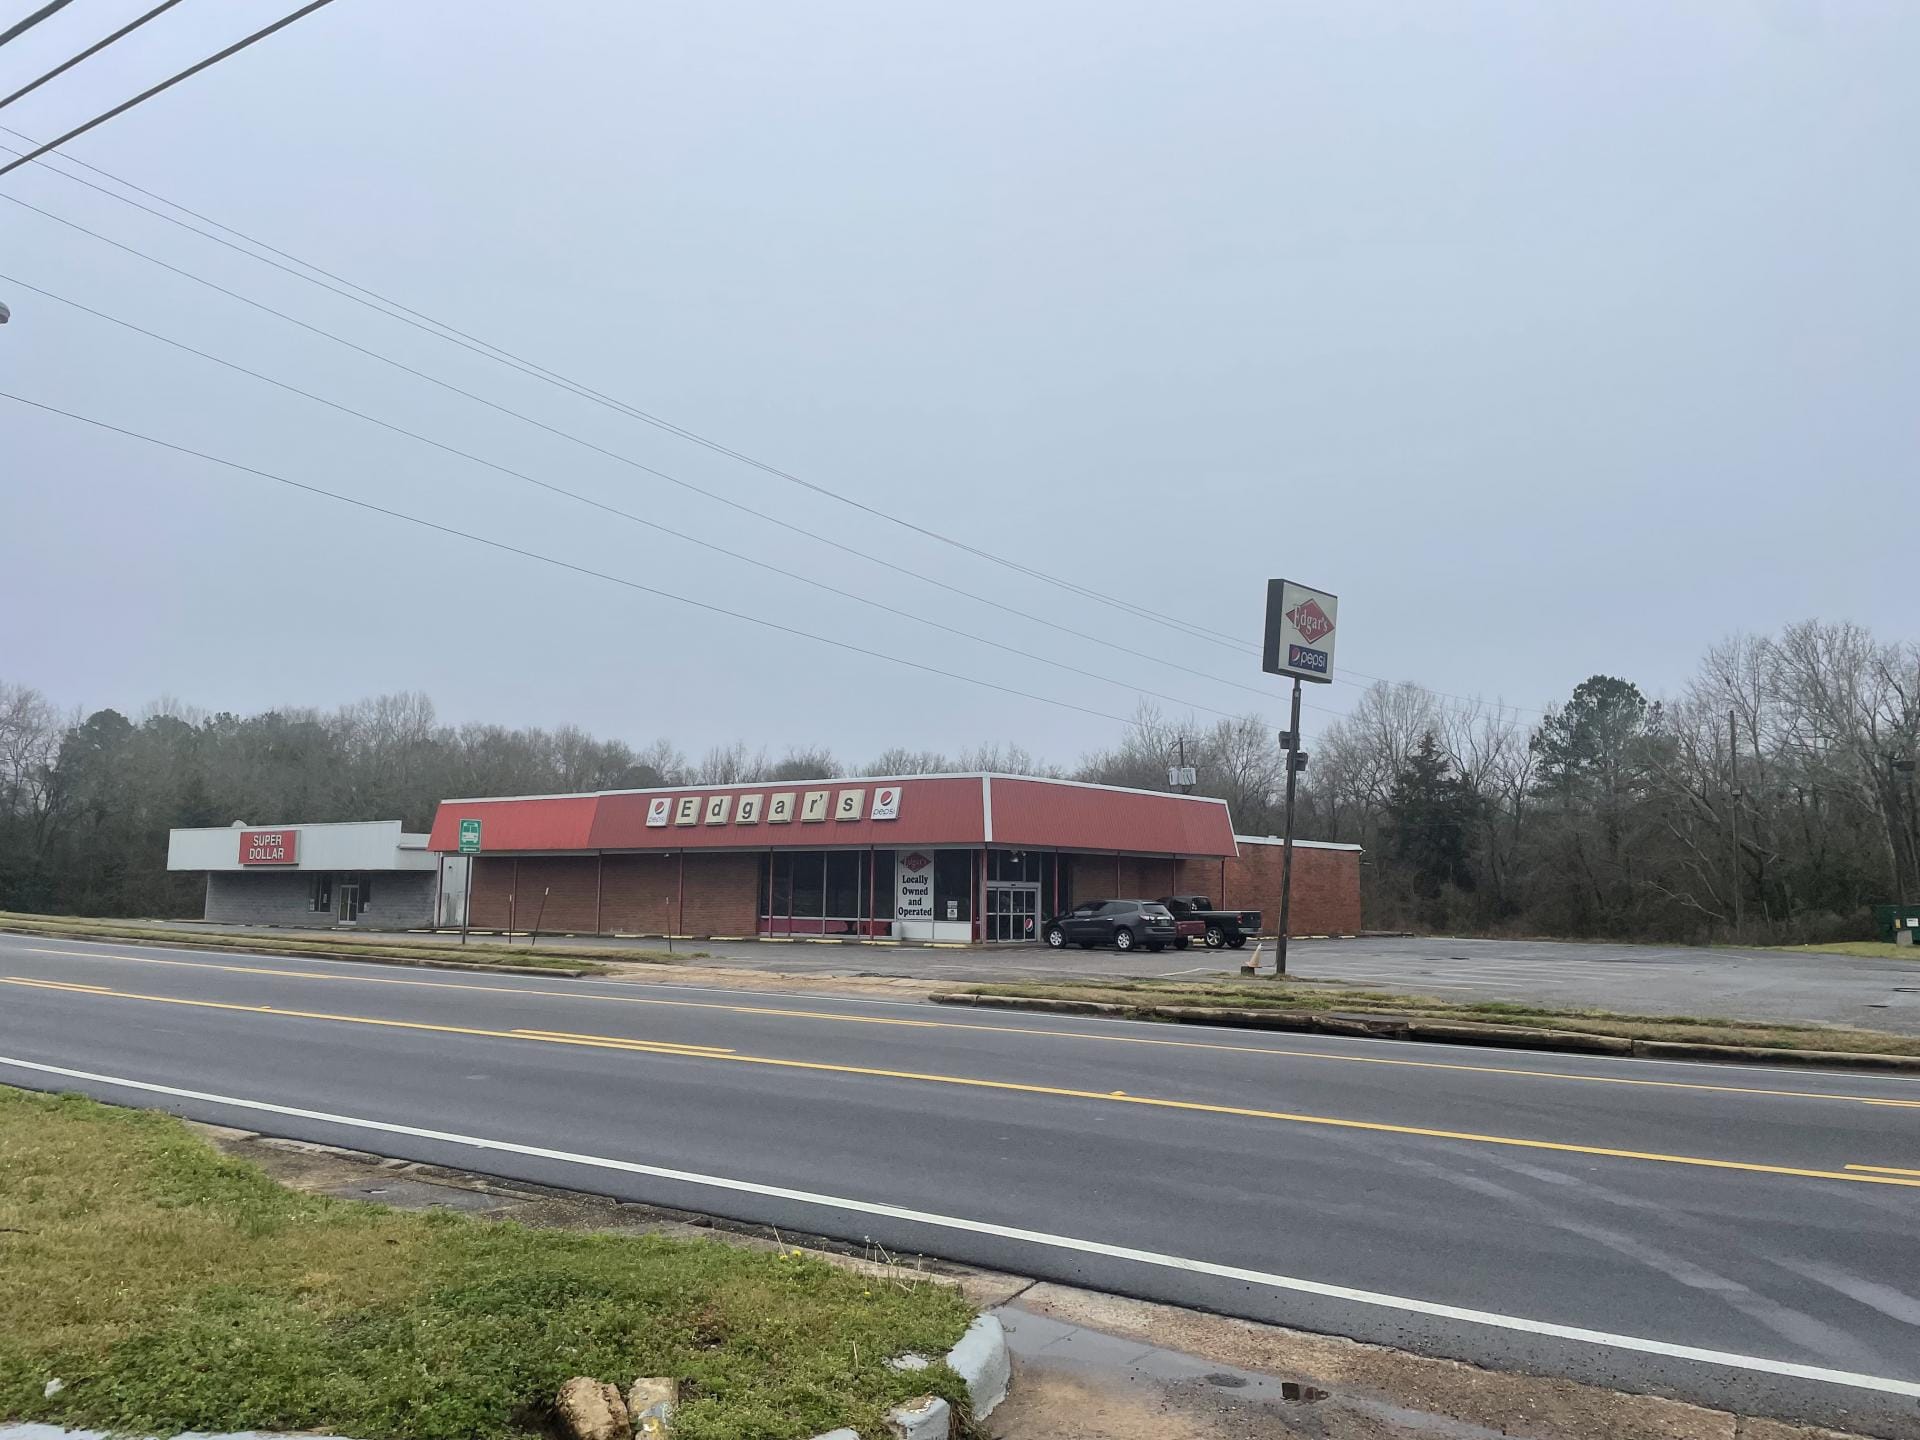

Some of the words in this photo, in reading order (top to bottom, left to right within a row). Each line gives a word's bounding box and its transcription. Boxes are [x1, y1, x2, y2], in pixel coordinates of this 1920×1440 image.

[1292, 604, 1328, 635] Edgar's
[1300, 651, 1326, 668] pepsi
[681, 794, 854, 819] Edgar's
[873, 808, 896, 816] pepsi
[253, 835, 282, 846] SUPER
[249, 848, 284, 859] DOLLAR
[902, 875, 928, 885] Locally
[902, 887, 928, 895] Owned
[908, 897, 922, 906] and
[898, 907, 932, 917] Operated
